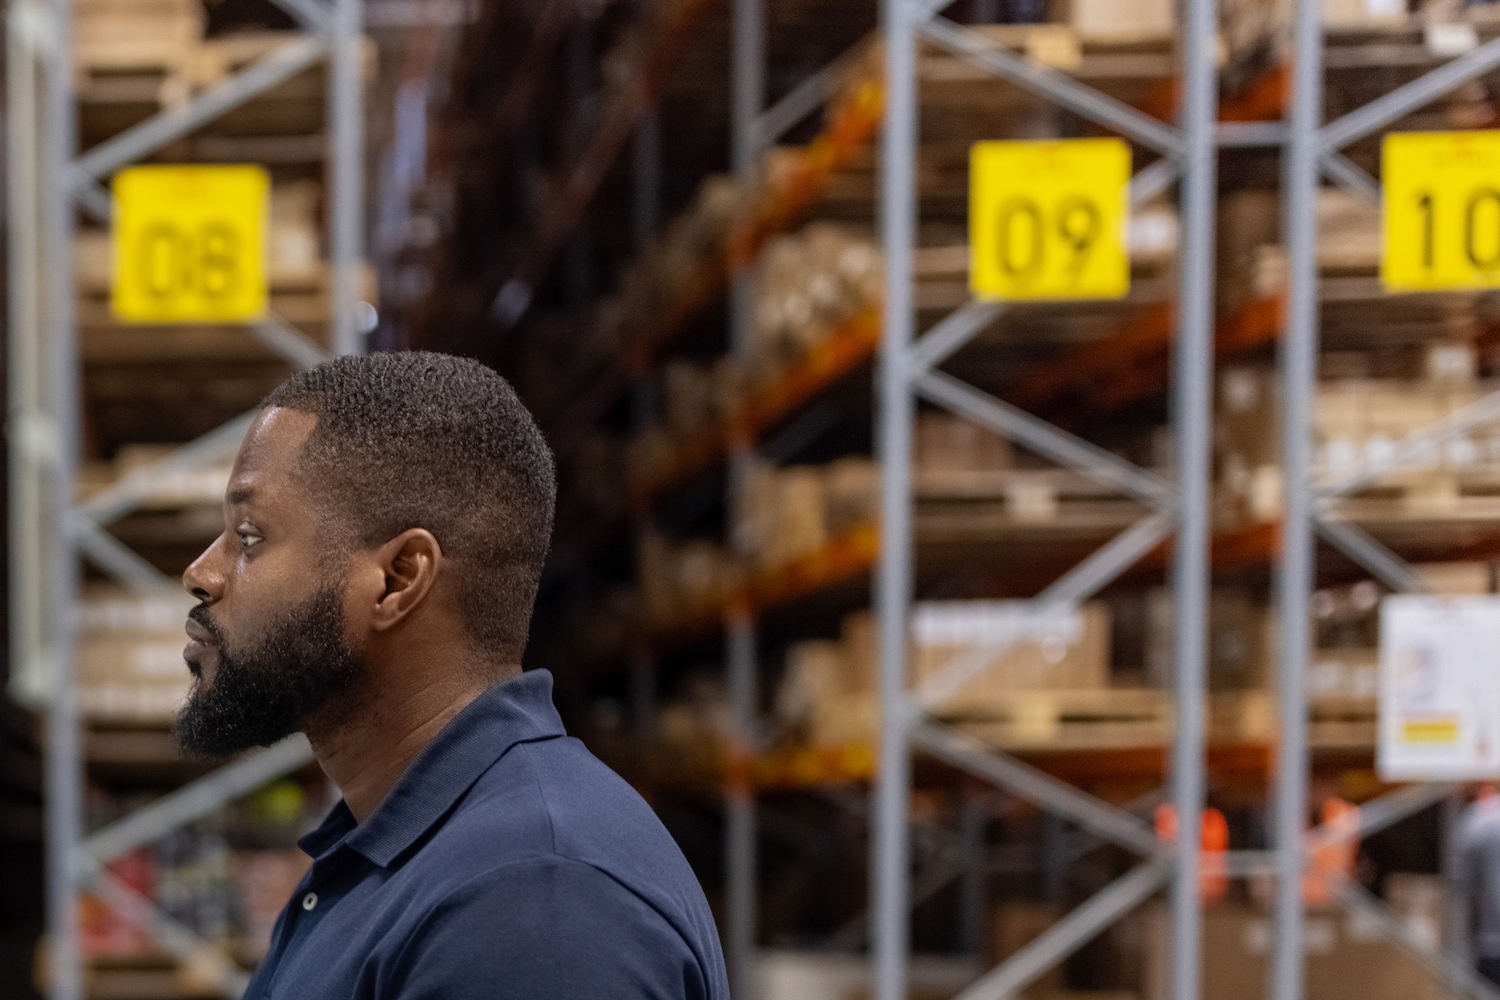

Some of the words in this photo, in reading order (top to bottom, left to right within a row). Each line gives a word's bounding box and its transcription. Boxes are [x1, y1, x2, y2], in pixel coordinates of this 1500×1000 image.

[135, 218, 243, 299] 08
[998, 197, 1100, 279] 09
[1415, 187, 1500, 271] 10
